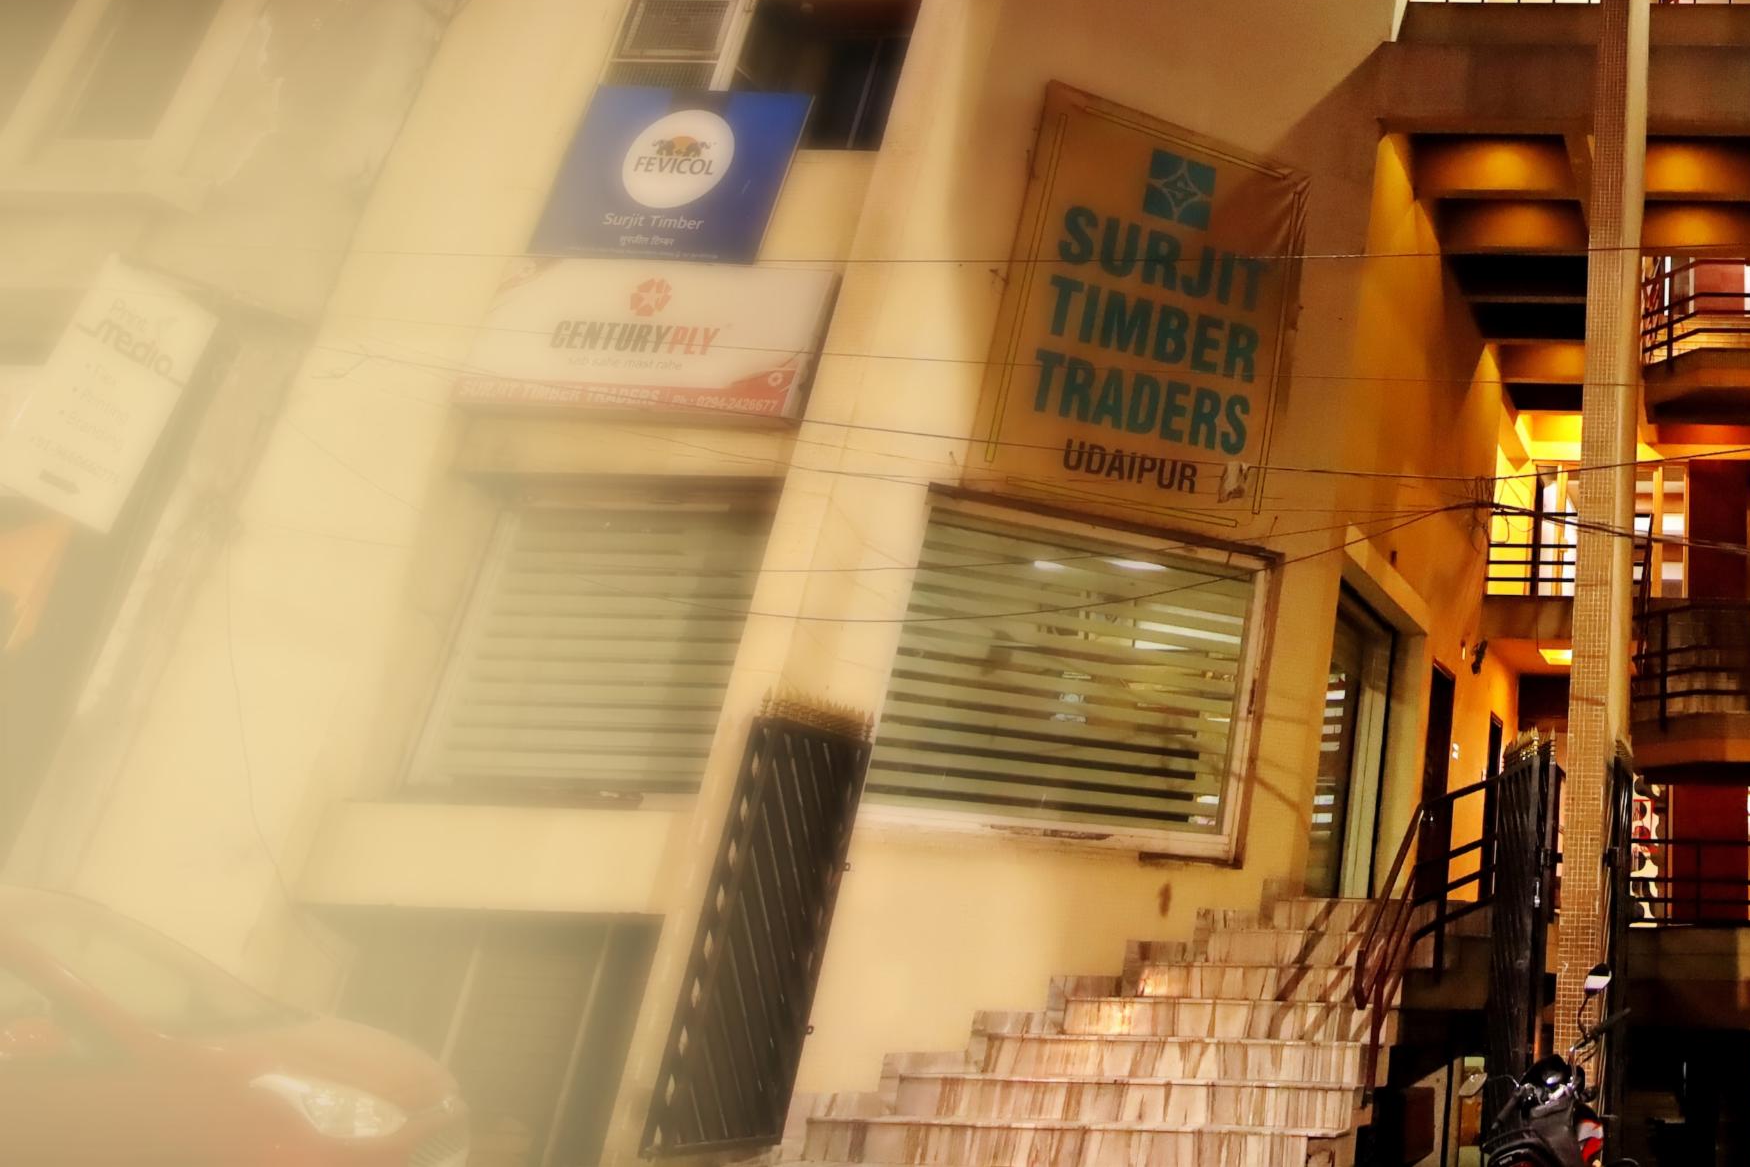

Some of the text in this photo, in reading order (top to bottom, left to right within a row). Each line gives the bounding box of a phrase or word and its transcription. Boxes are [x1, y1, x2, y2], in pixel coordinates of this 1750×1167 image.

[633, 155, 715, 177] FEVICOL
[602, 211, 705, 231] Surjit Timber
[1057, 205, 1271, 313] SURJIT
[549, 319, 721, 356] CENTURYPLY
[1048, 274, 1261, 383] TIMBER
[1033, 348, 1251, 456] TRADERS
[1062, 438, 1198, 494] UDAIPUR
